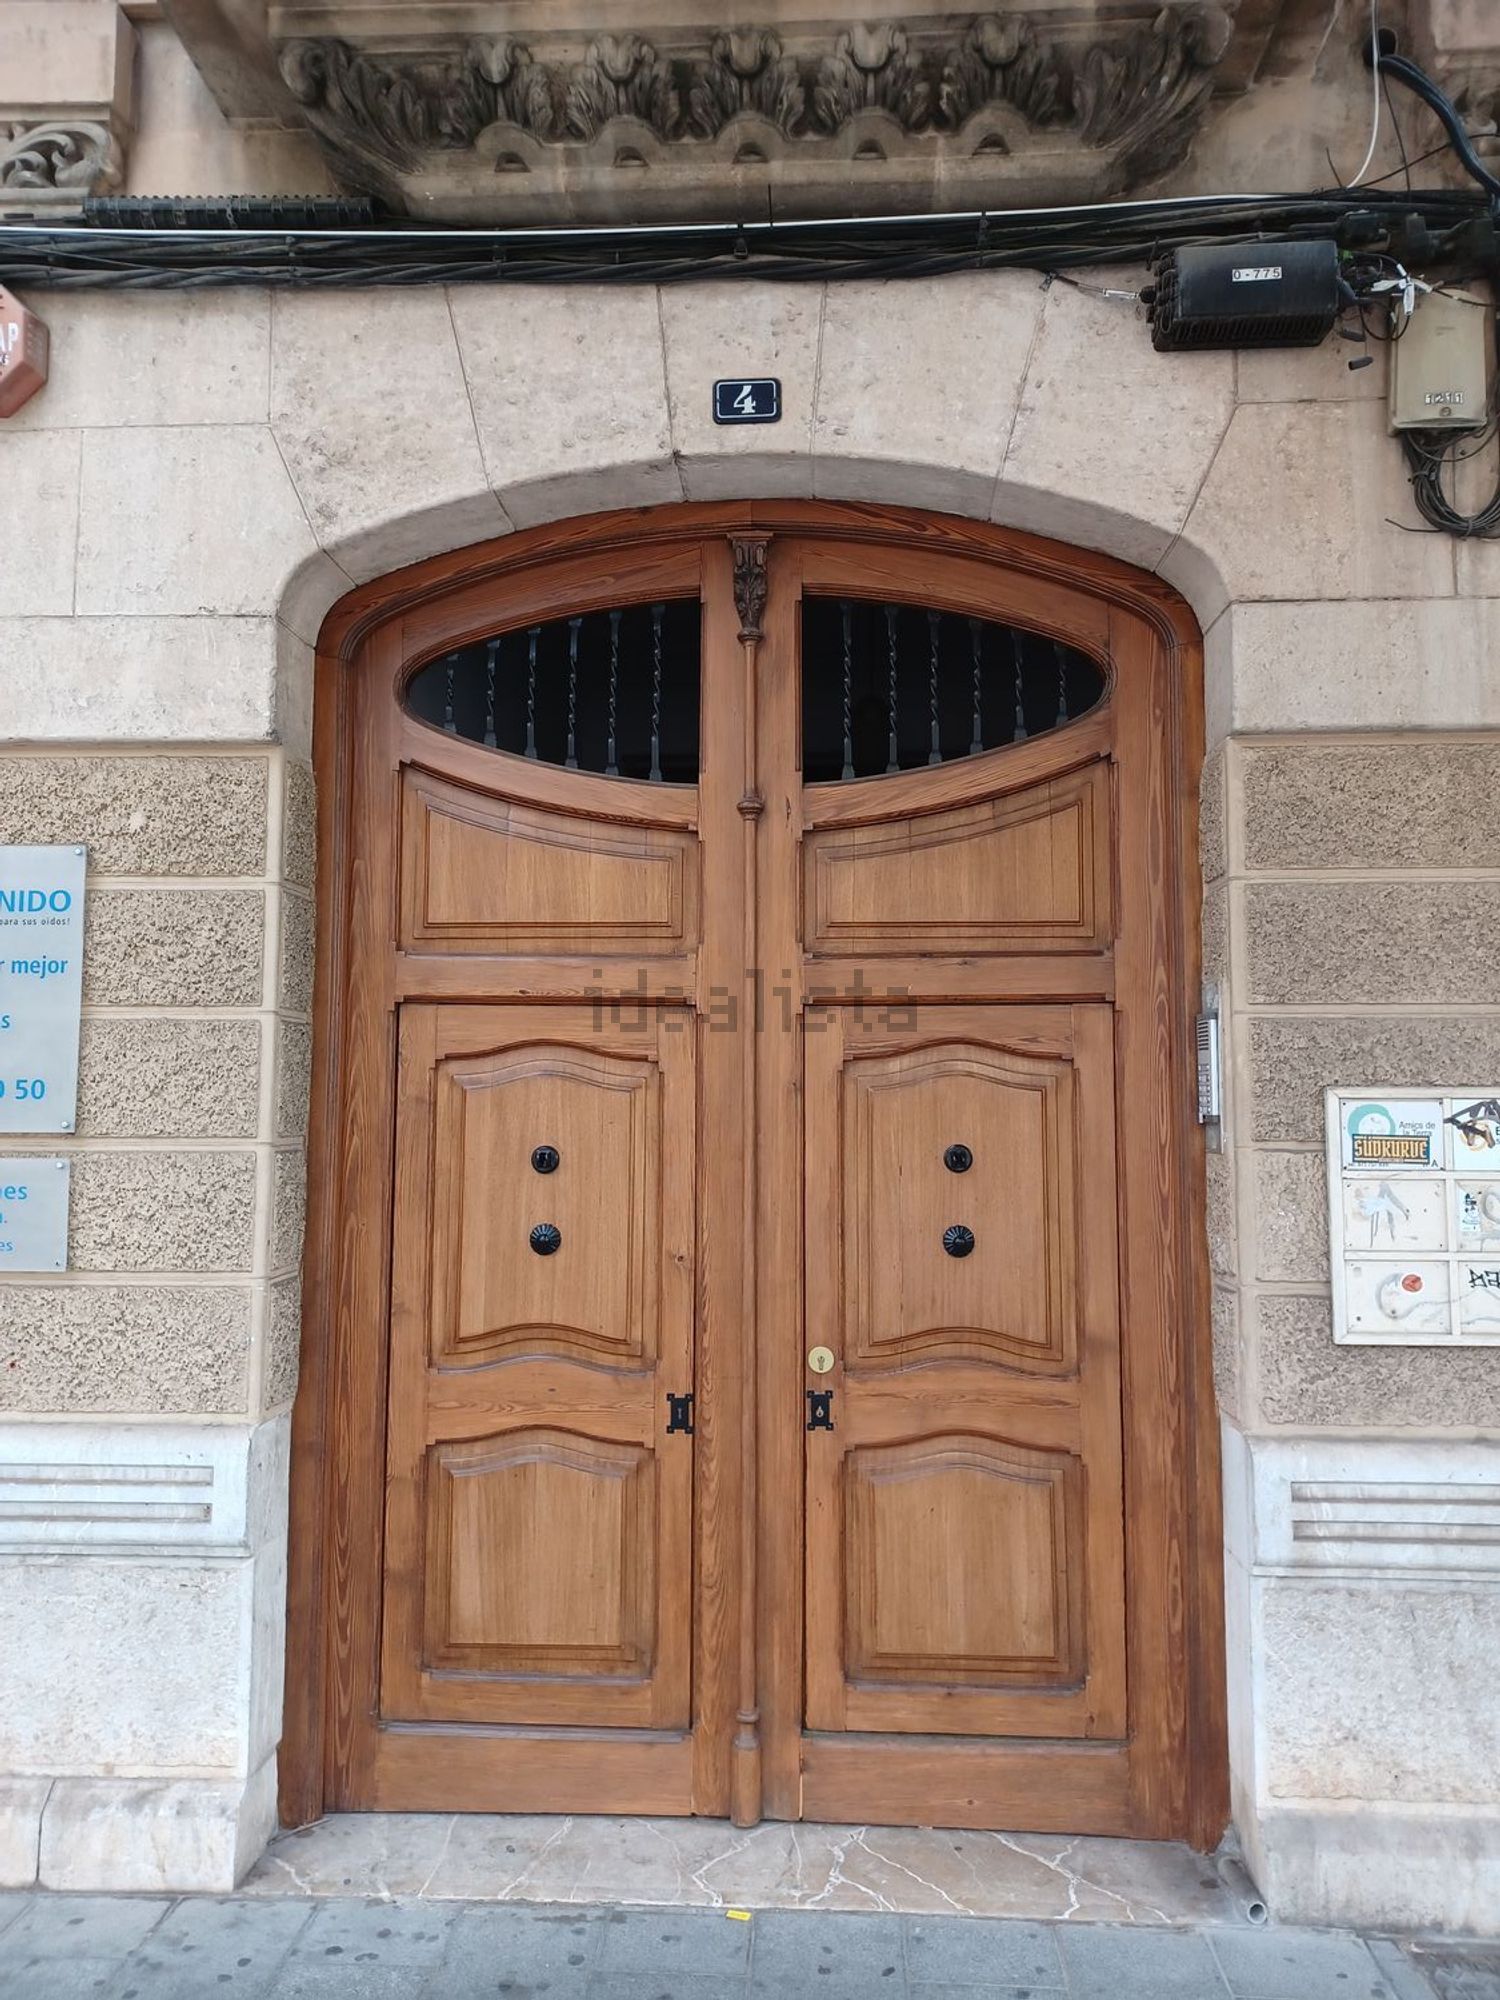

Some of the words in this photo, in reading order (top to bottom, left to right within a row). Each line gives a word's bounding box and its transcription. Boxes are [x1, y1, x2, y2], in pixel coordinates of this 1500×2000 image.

[733, 385, 756, 414] 4
[11, 955, 68, 979] mejor
[15, 1079, 46, 1100] 50
[0, 1185, 27, 1200] es
